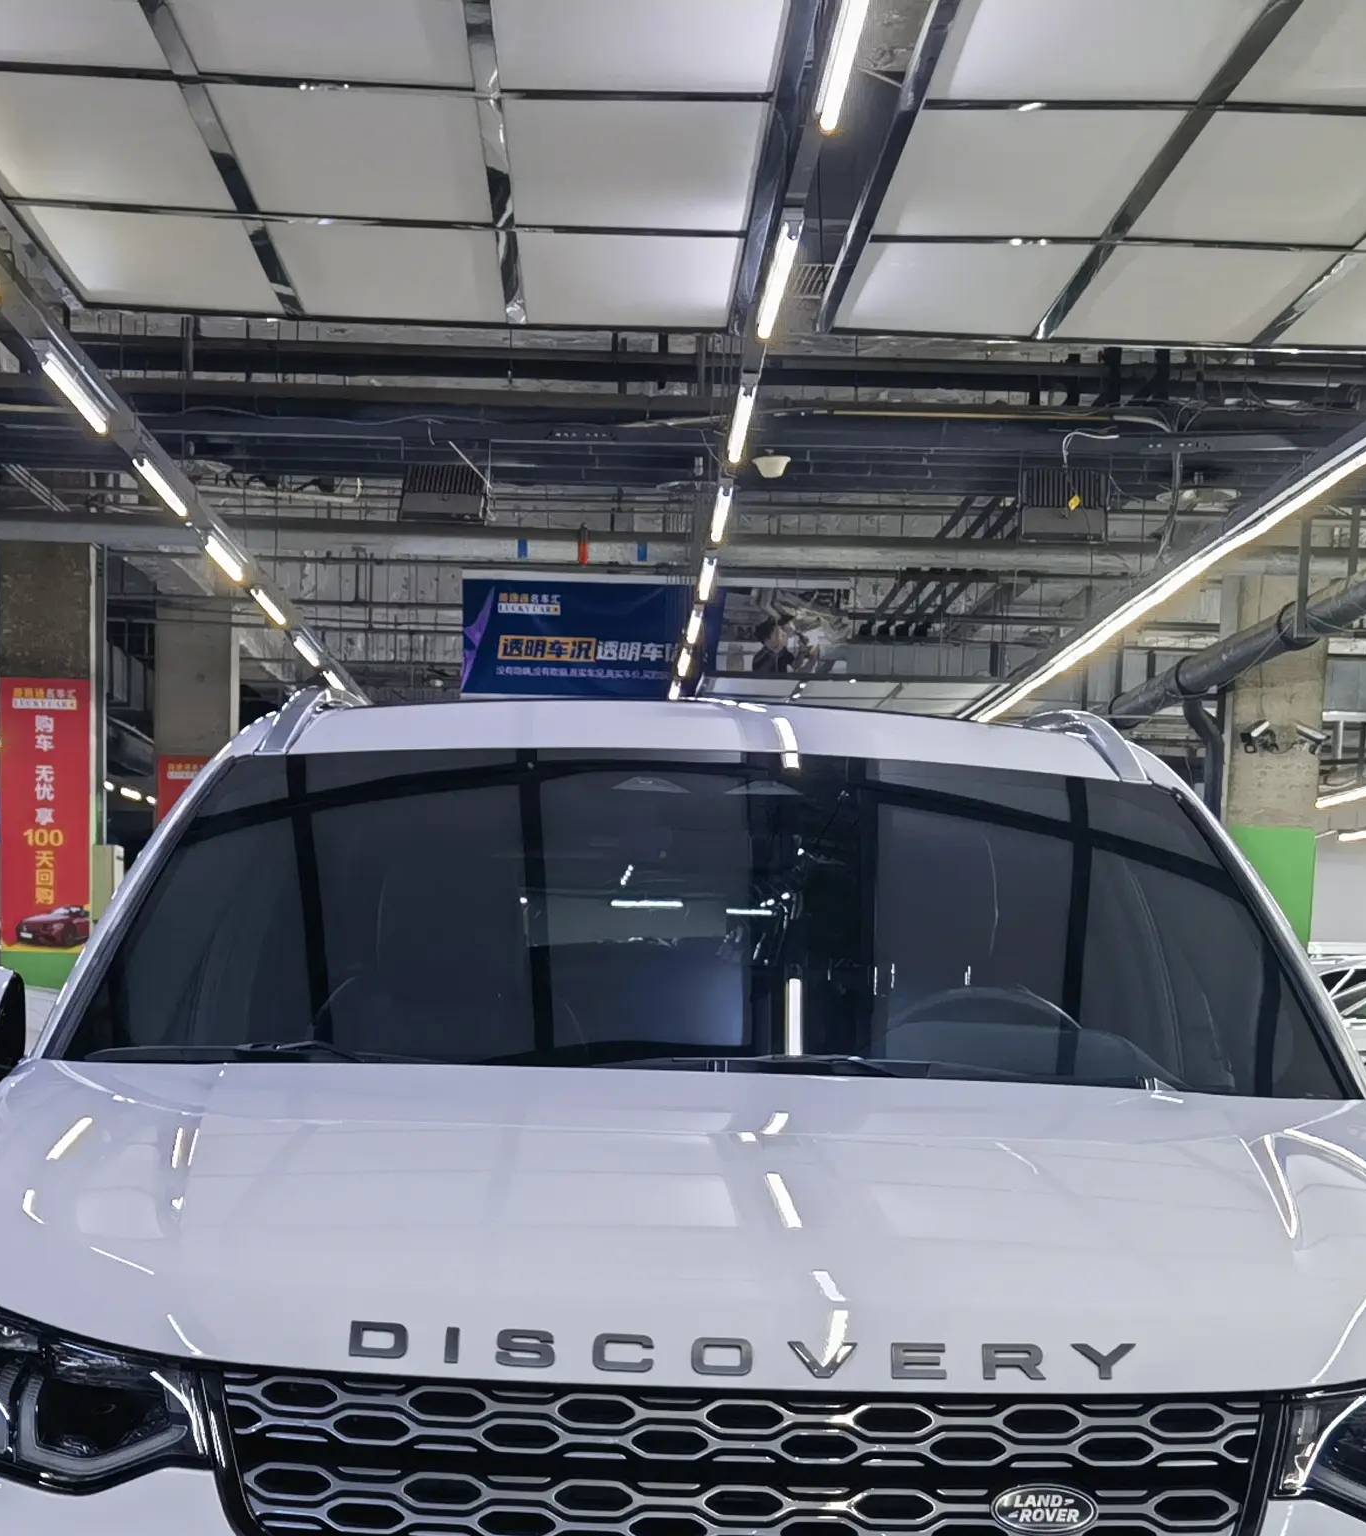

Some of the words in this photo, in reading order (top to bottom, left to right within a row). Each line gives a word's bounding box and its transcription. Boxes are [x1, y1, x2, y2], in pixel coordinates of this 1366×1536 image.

[502, 637, 594, 660] 透明车况
[348, 1320, 1136, 1381] DISCOVERY
[1013, 1494, 1063, 1508] LAND
[1018, 1508, 1080, 1522] ROVER
